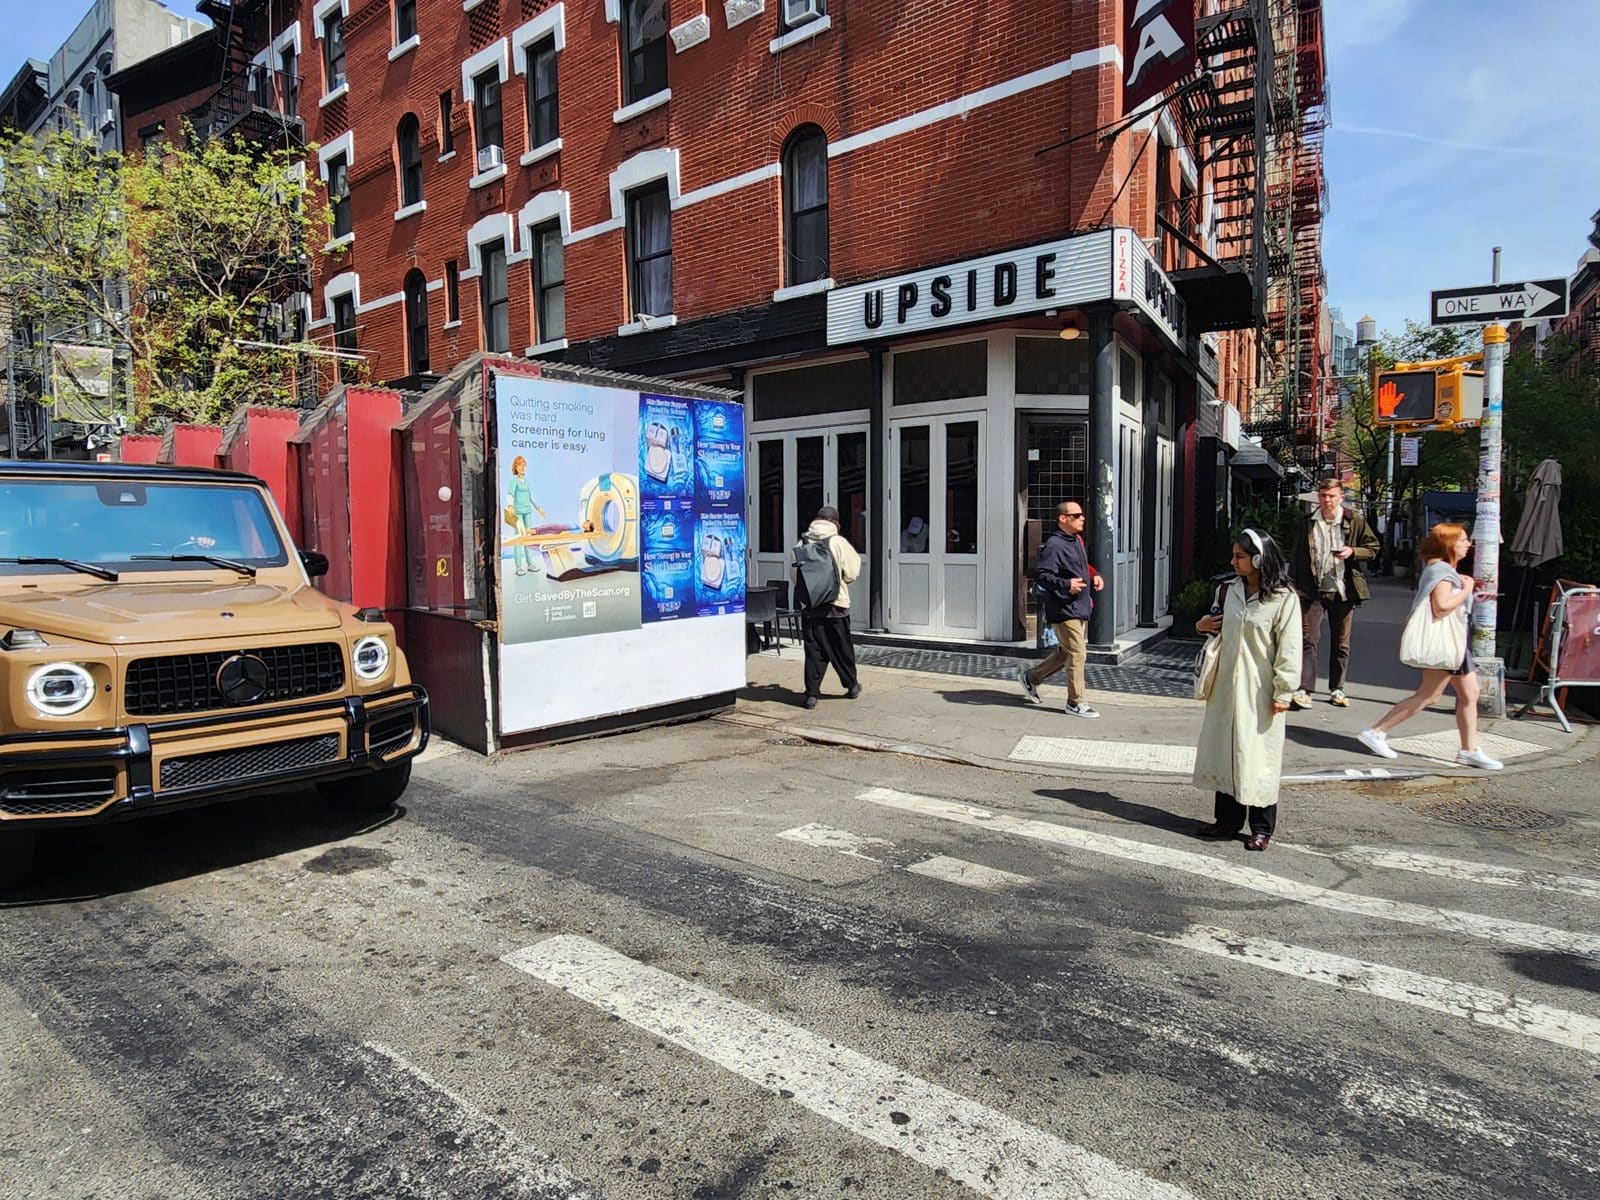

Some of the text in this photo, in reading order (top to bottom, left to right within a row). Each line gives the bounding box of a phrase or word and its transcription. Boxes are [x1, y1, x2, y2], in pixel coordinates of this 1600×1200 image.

[1119, 235, 1127, 292] PIZZA
[864, 252, 1057, 330] UPSIDE
[1445, 292, 1539, 314] ONE WAY
[510, 395, 594, 415] Quitting smoking
[510, 411, 557, 422] was hard
[511, 423, 606, 441] Screening for lung
[511, 439, 589, 453] cancer is easy.
[514, 586, 630, 604] Get SavedByTheScan.org
